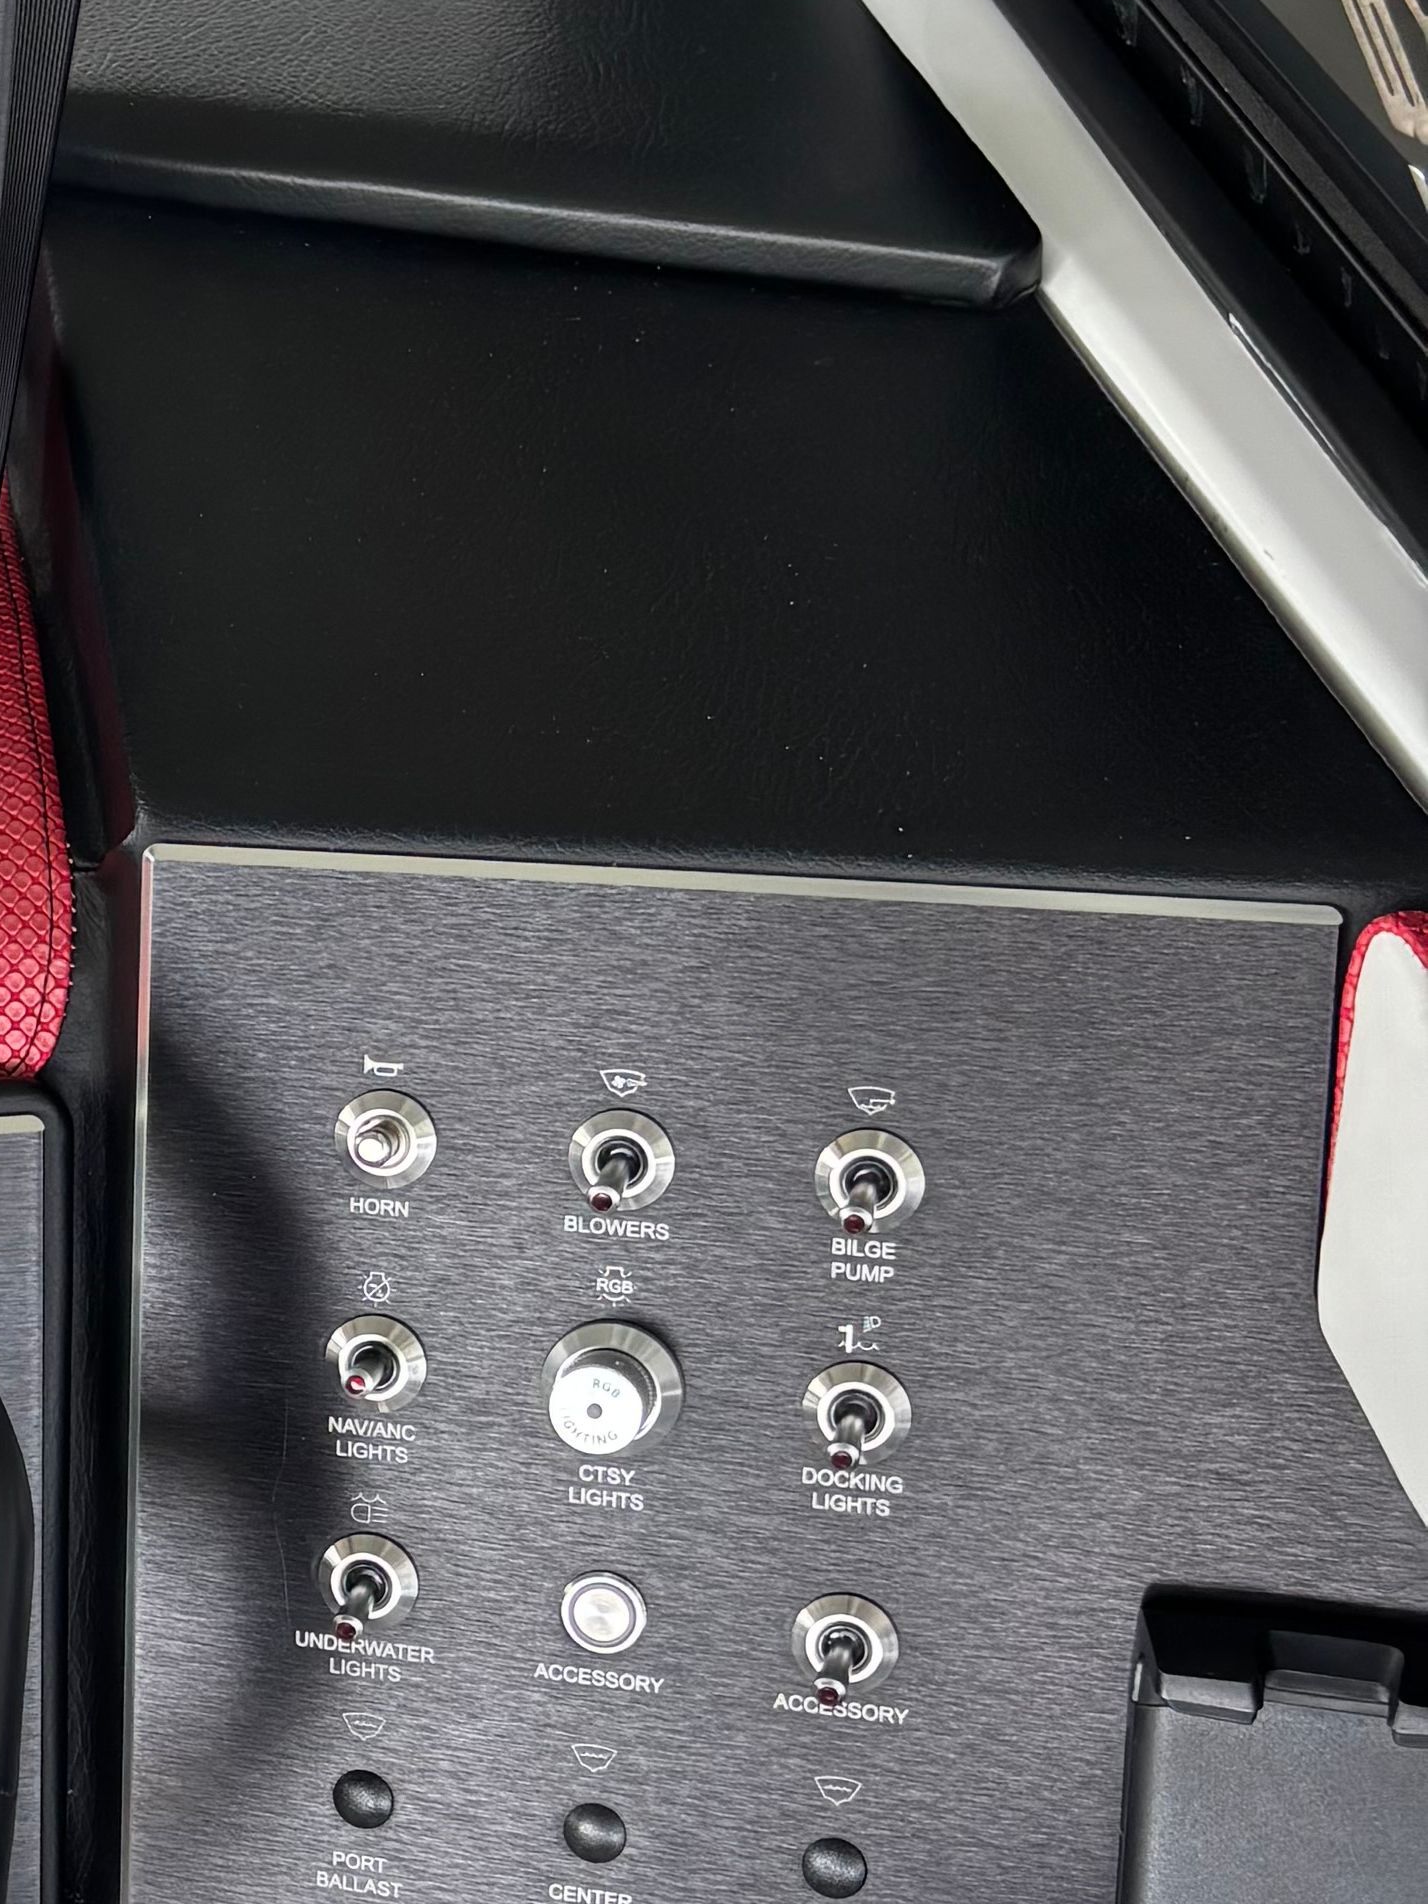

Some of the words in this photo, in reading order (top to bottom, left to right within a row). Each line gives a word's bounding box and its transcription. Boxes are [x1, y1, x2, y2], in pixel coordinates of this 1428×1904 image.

[348, 1197, 410, 1218] HORN
[563, 1214, 670, 1241] BLOWERS
[830, 1237, 897, 1261] BILGE
[596, 1277, 634, 1295] RGB
[830, 1262, 895, 1284] PUMP
[327, 1415, 416, 1443] NAV/ANC
[335, 1440, 409, 1464] LIGHTS
[578, 1464, 636, 1487] CTSY
[801, 1466, 904, 1495] DOCKING
[568, 1486, 645, 1513] LIGHTS
[811, 1492, 891, 1518] LIGHTS
[295, 1630, 435, 1664] UNDERWATER
[329, 1658, 402, 1683] LIGHTS
[534, 1663, 665, 1695] ACCESSORY
[772, 1692, 909, 1725] ACCESSORY
[332, 1851, 388, 1874] PORT
[316, 1871, 403, 1899] BALLAST
